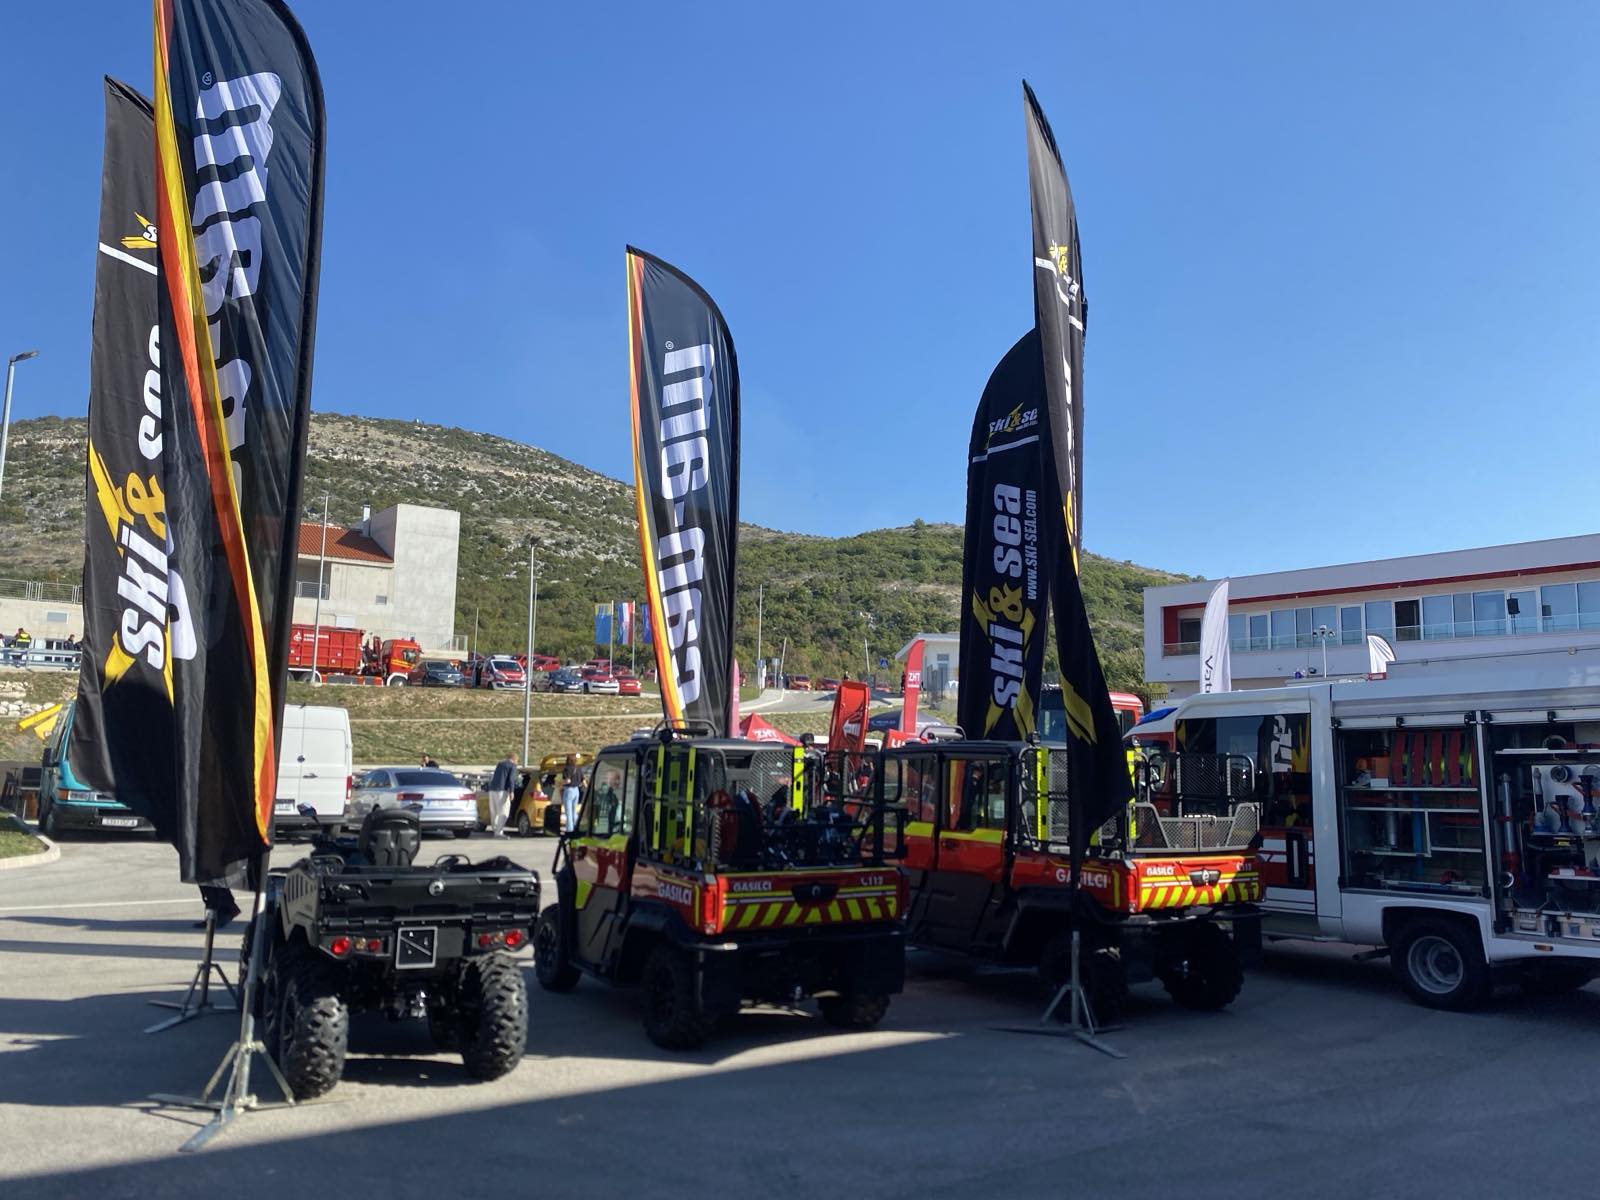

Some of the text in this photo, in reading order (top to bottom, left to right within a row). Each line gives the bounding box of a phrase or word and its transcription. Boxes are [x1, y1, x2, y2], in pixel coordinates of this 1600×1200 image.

[118, 525, 169, 669] ski
[989, 484, 1024, 709] ski & sea
[657, 881, 692, 905] GASILCI
[733, 881, 772, 892] GASILCI
